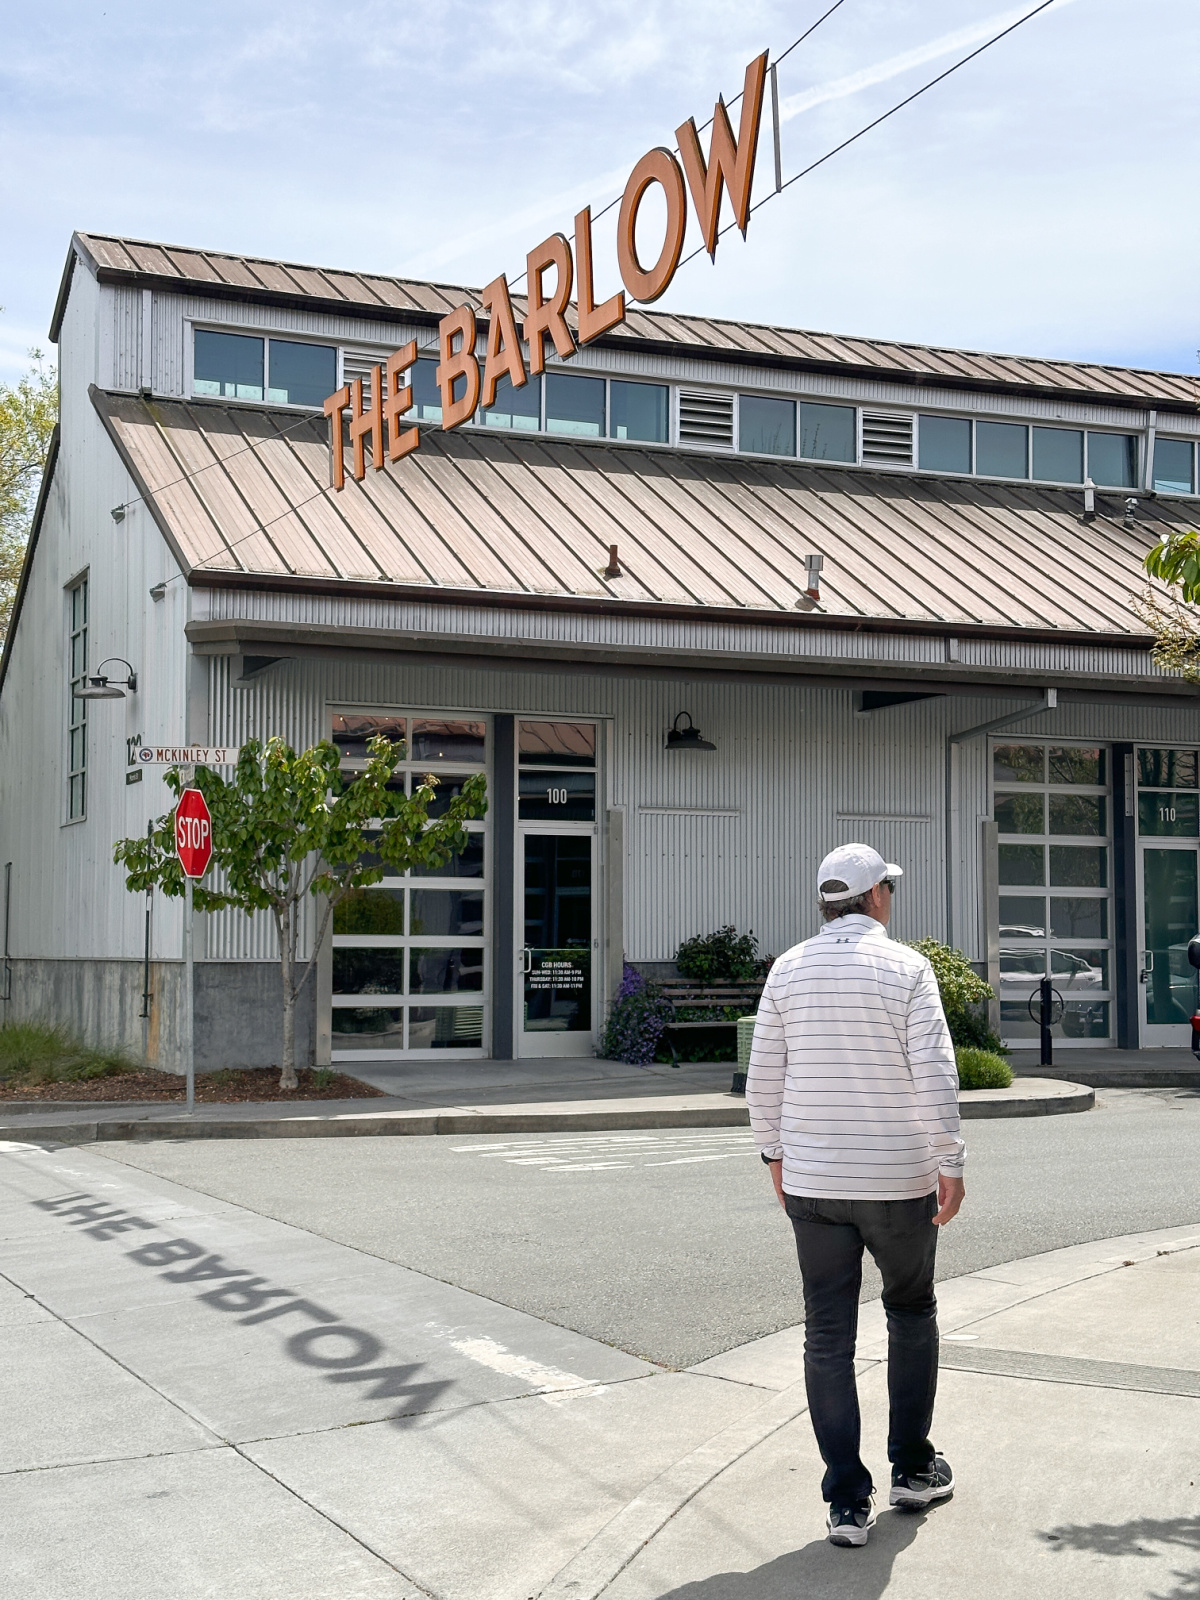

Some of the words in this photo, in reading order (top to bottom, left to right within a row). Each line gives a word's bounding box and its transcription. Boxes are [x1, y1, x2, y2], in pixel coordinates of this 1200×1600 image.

[324, 338, 420, 491] THE
[436, 48, 769, 431] BARLOW
[156, 748, 210, 762] MCKINLEY
[214, 749, 227, 763] ST
[546, 787, 568, 804] 100
[1159, 807, 1176, 822] 110
[178, 815, 209, 850] STOP
[553, 961, 572, 969] HOURS
